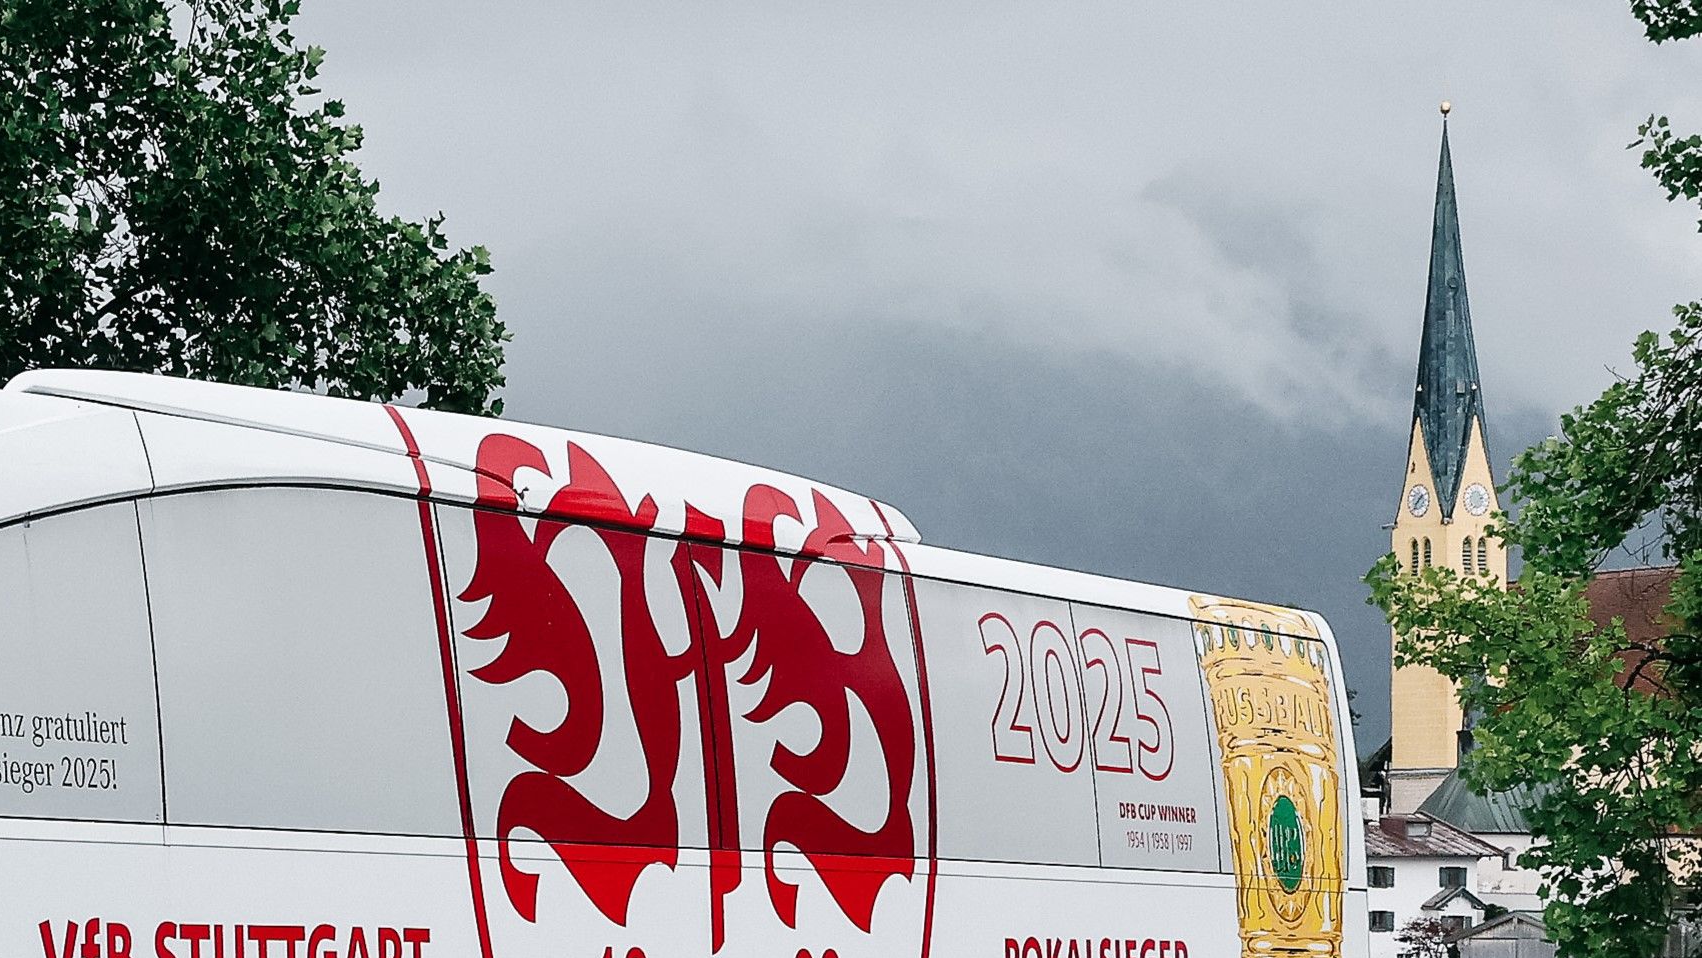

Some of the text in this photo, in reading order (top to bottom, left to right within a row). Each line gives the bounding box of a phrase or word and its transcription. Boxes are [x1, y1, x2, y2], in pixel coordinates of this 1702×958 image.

[978, 612, 1174, 781] 2025
[32, 711, 128, 747] gratuliert
[61, 756, 117, 790] 2025!
[1119, 802, 1197, 823] DFB CUP WINNER
[1126, 831, 1193, 851] 1954 1958 1997
